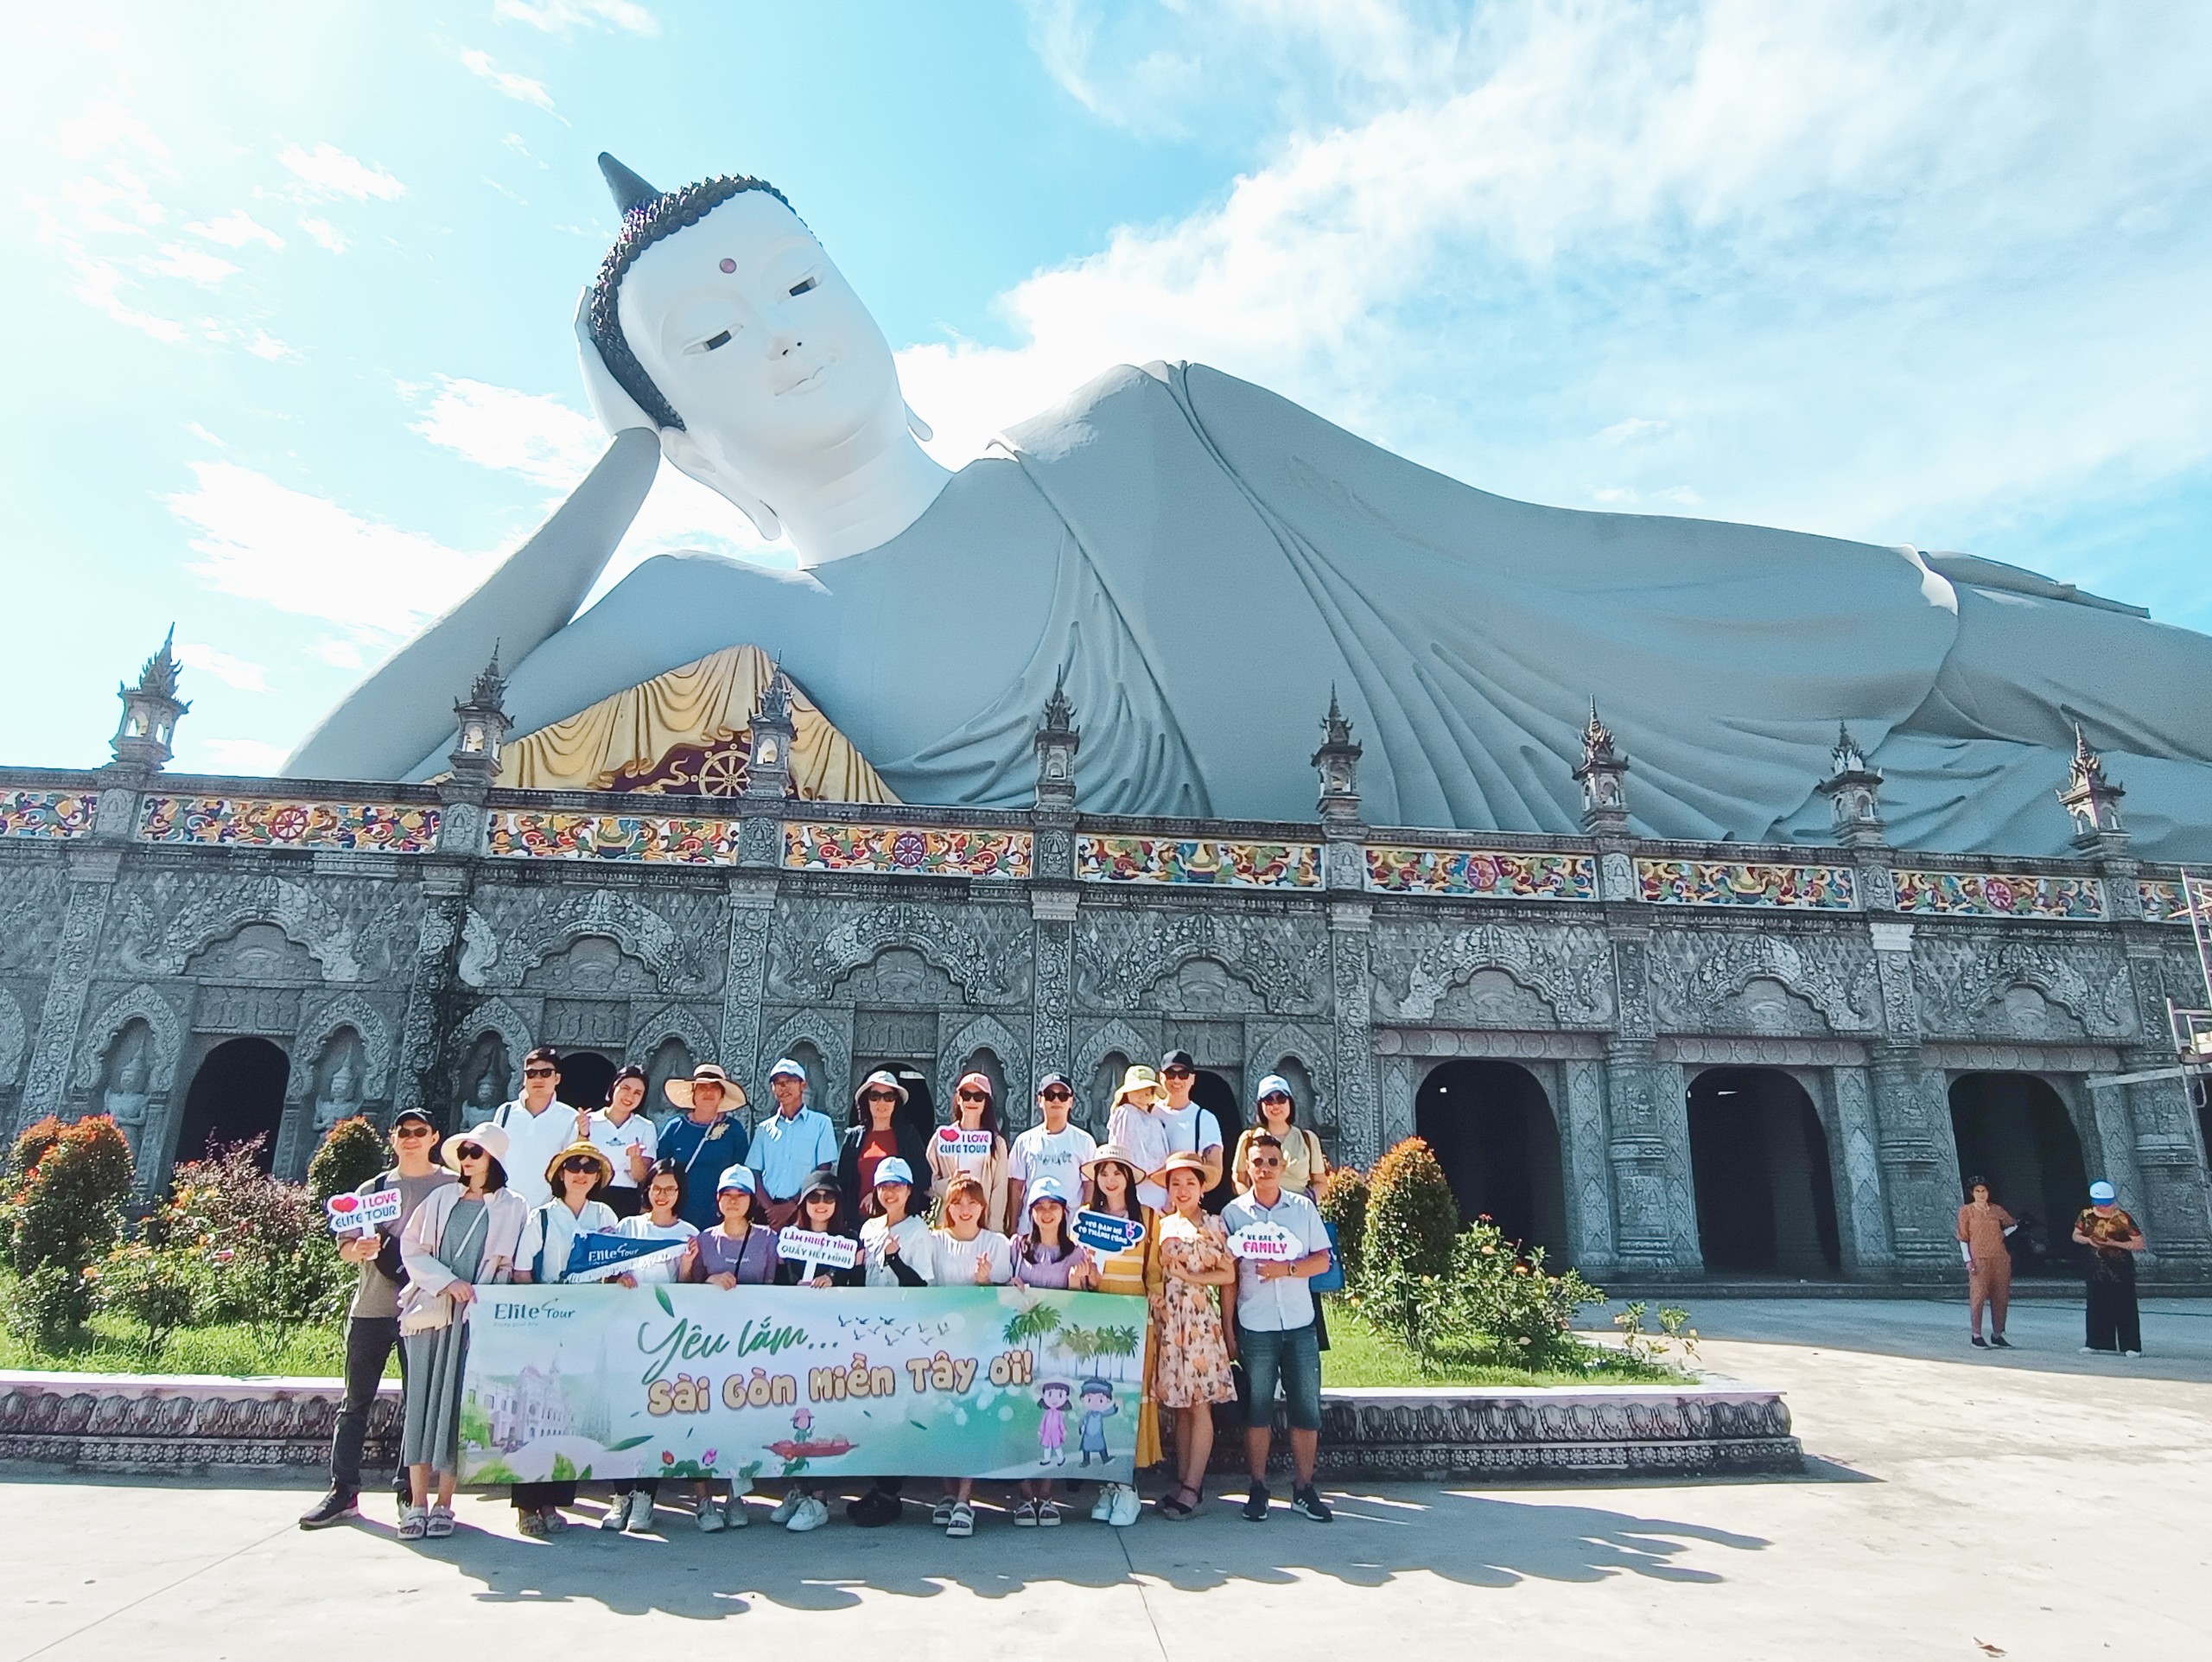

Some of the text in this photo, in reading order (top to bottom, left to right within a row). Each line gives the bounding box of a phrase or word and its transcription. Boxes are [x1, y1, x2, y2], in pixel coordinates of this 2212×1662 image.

[968, 1134, 989, 1143] LOVE
[963, 1144, 987, 1154] TOUR
[369, 1192, 397, 1207] LOVE
[335, 1205, 397, 1228] ELITE TOUR
[1243, 1240, 1287, 1254] FAMILY
[494, 1297, 575, 1320] Elite Tour
[637, 1317, 730, 1385] Yêu
[808, 1353, 896, 1403] Miền
[906, 1350, 979, 1394] Tây
